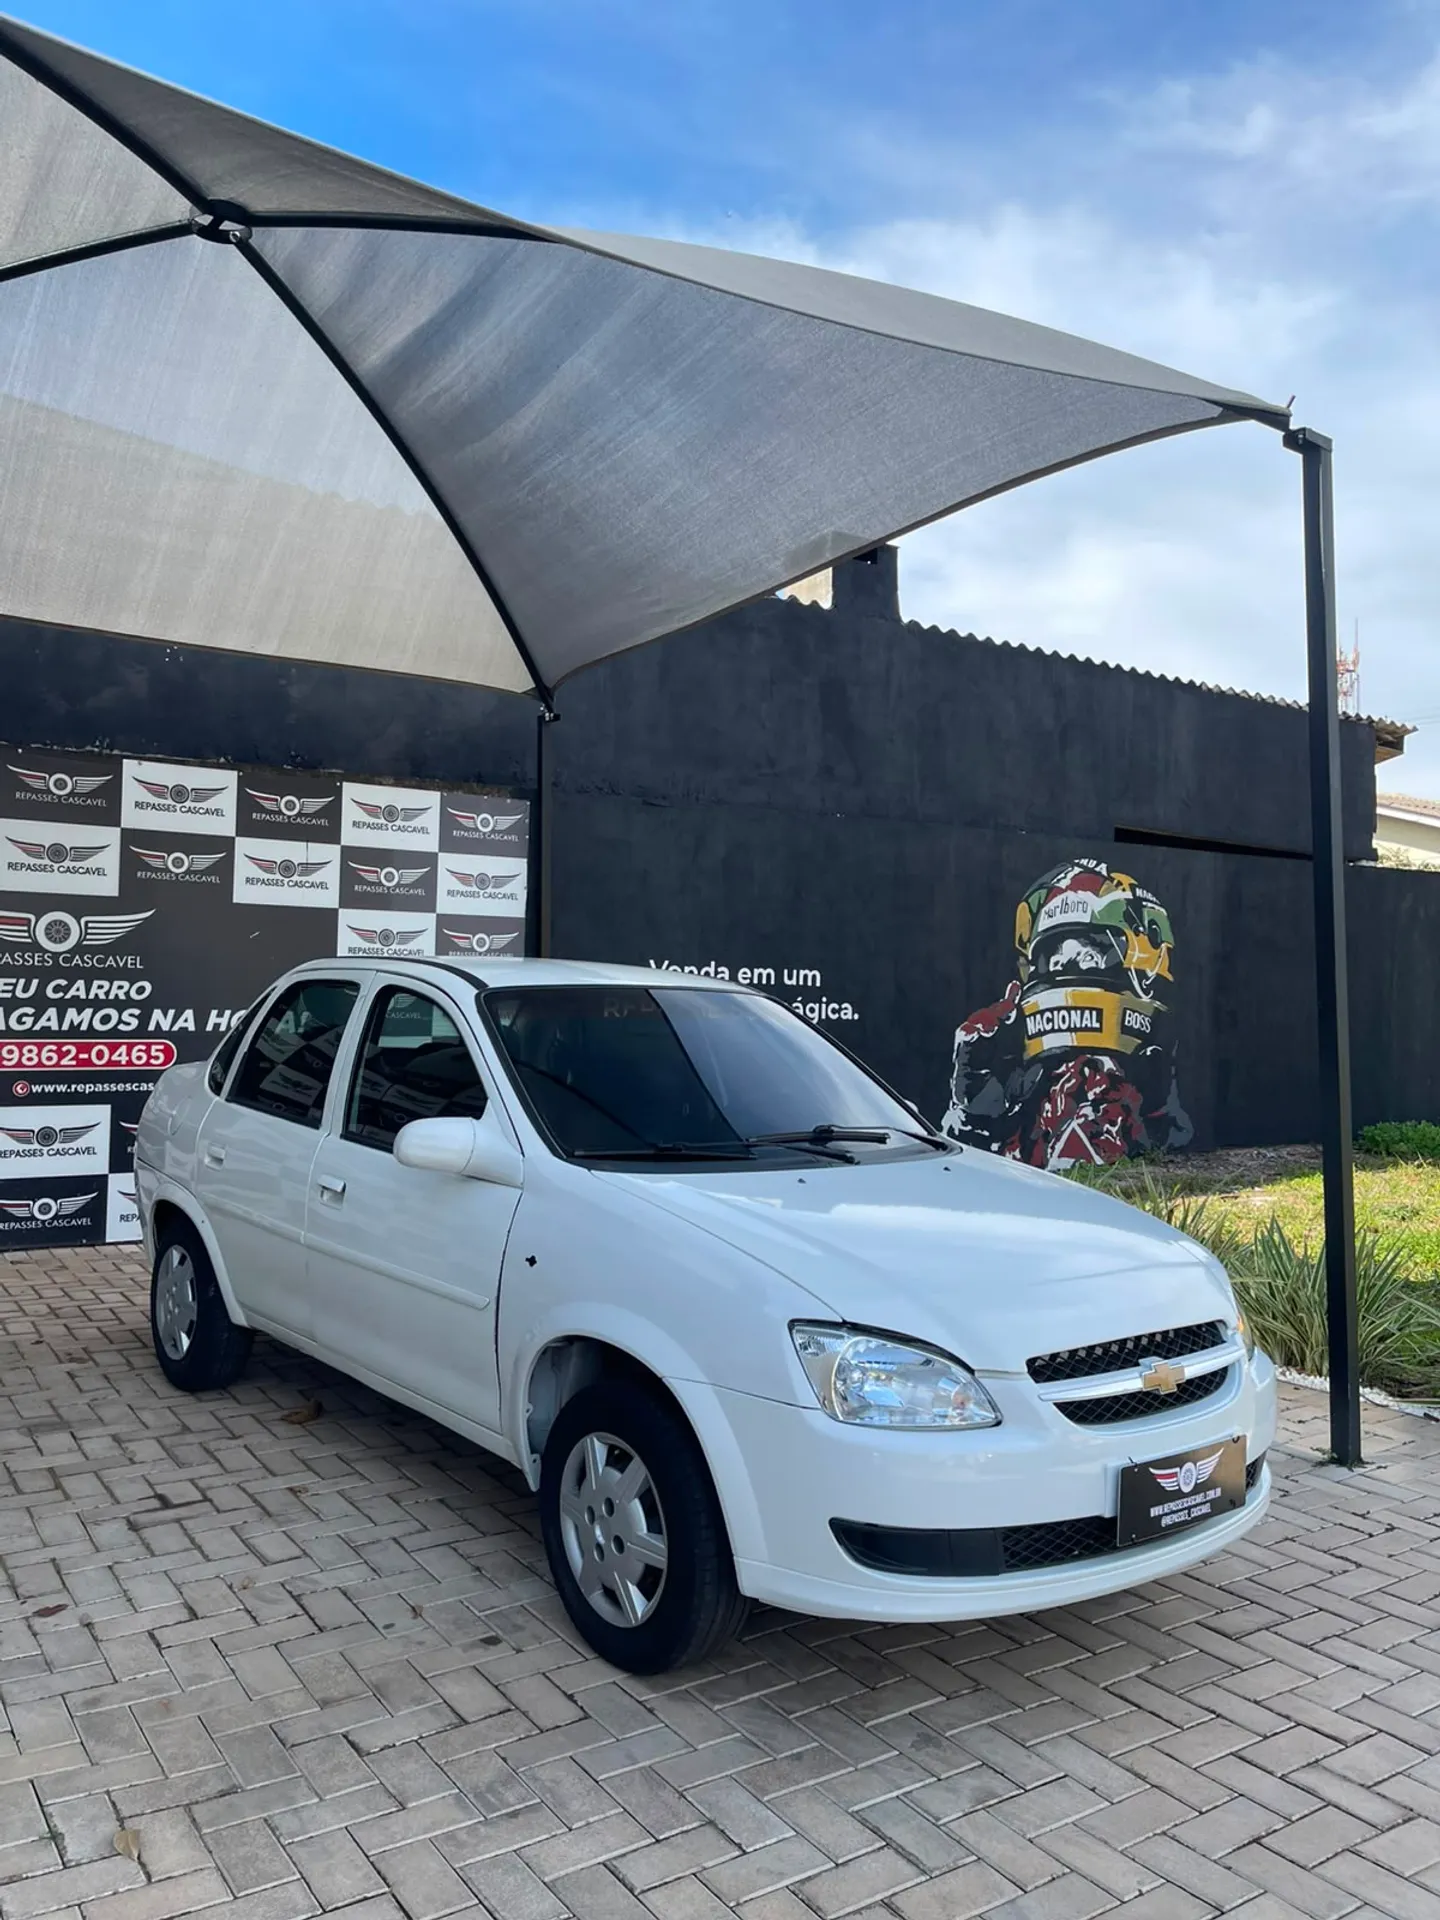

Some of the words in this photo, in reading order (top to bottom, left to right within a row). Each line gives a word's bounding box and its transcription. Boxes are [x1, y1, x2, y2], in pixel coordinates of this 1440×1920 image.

[15, 791, 58, 803] REPASSES
[61, 795, 107, 807] CASCAVEL
[134, 801, 177, 813] REPASSES
[180, 805, 225, 817] CASCAVEL
[252, 812, 288, 823] REPASSES
[290, 815, 329, 827] CASCAVEL
[352, 820, 388, 832] REPASSES
[390, 823, 430, 835] CASCAVEL
[453, 830, 483, 840] REPASSES
[485, 832, 519, 842] CASCAVEL
[8, 862, 54, 873] REPASSES
[57, 864, 107, 876] CASCAVEL
[137, 870, 176, 881] REPASSES
[178, 873, 220, 884] CASCAVEL
[245, 877, 285, 888] REPASSES
[287, 879, 329, 890] CASCAVEL
[354, 884, 388, 894] REPASSES
[390, 886, 425, 896] CASCAVEL
[446, 889, 482, 899] REPASSES
[484, 891, 518, 901] CASCAVEL
[1043, 897, 1088, 919] Marlboro
[348, 946, 384, 955] REPASSES
[0, 952, 53, 966] ASSES
[59, 953, 144, 969] CASCAVEL
[737, 967, 775, 985] em
[783, 967, 821, 987] um
[45, 978, 152, 1000] CARRO
[0, 1006, 142, 1032] GAMOS
[147, 1008, 196, 1032] NA
[1025, 1009, 1100, 1036] NACIONAL
[1125, 1009, 1151, 1034] BOSS
[1, 1044, 165, 1066] 9862-0465
[31, 1082, 155, 1094] www.repassescas
[46, 1146, 97, 1157] CASCAVEL
[45, 1217, 92, 1228] CASCAVEL
